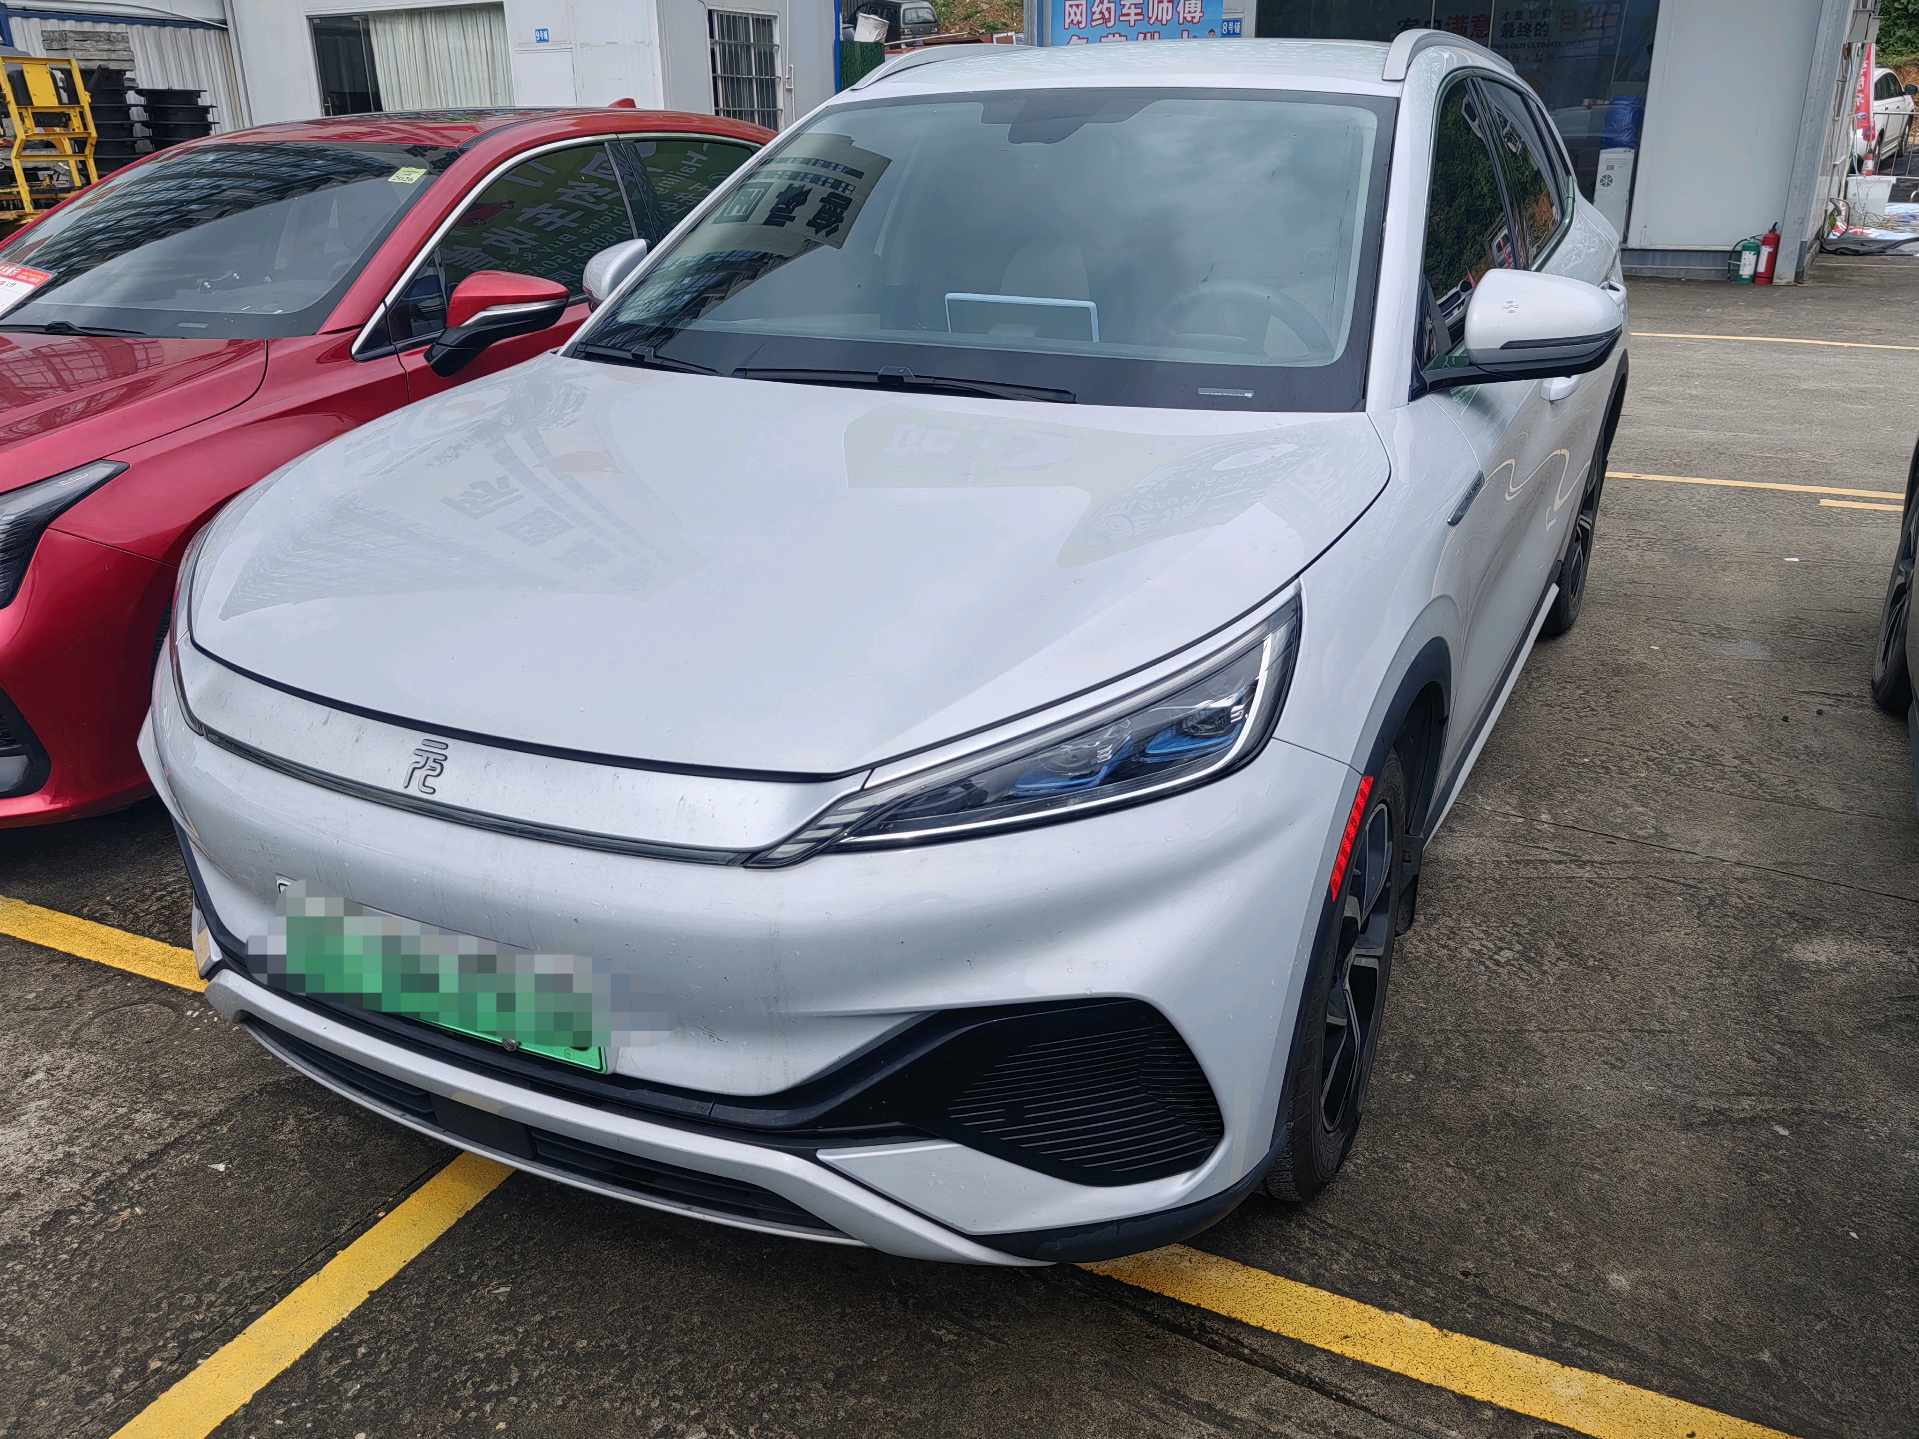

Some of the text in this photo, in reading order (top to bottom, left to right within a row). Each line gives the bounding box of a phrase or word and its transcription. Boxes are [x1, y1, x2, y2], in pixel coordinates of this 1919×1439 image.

[1064, 0, 1204, 29] 网约车师傅
